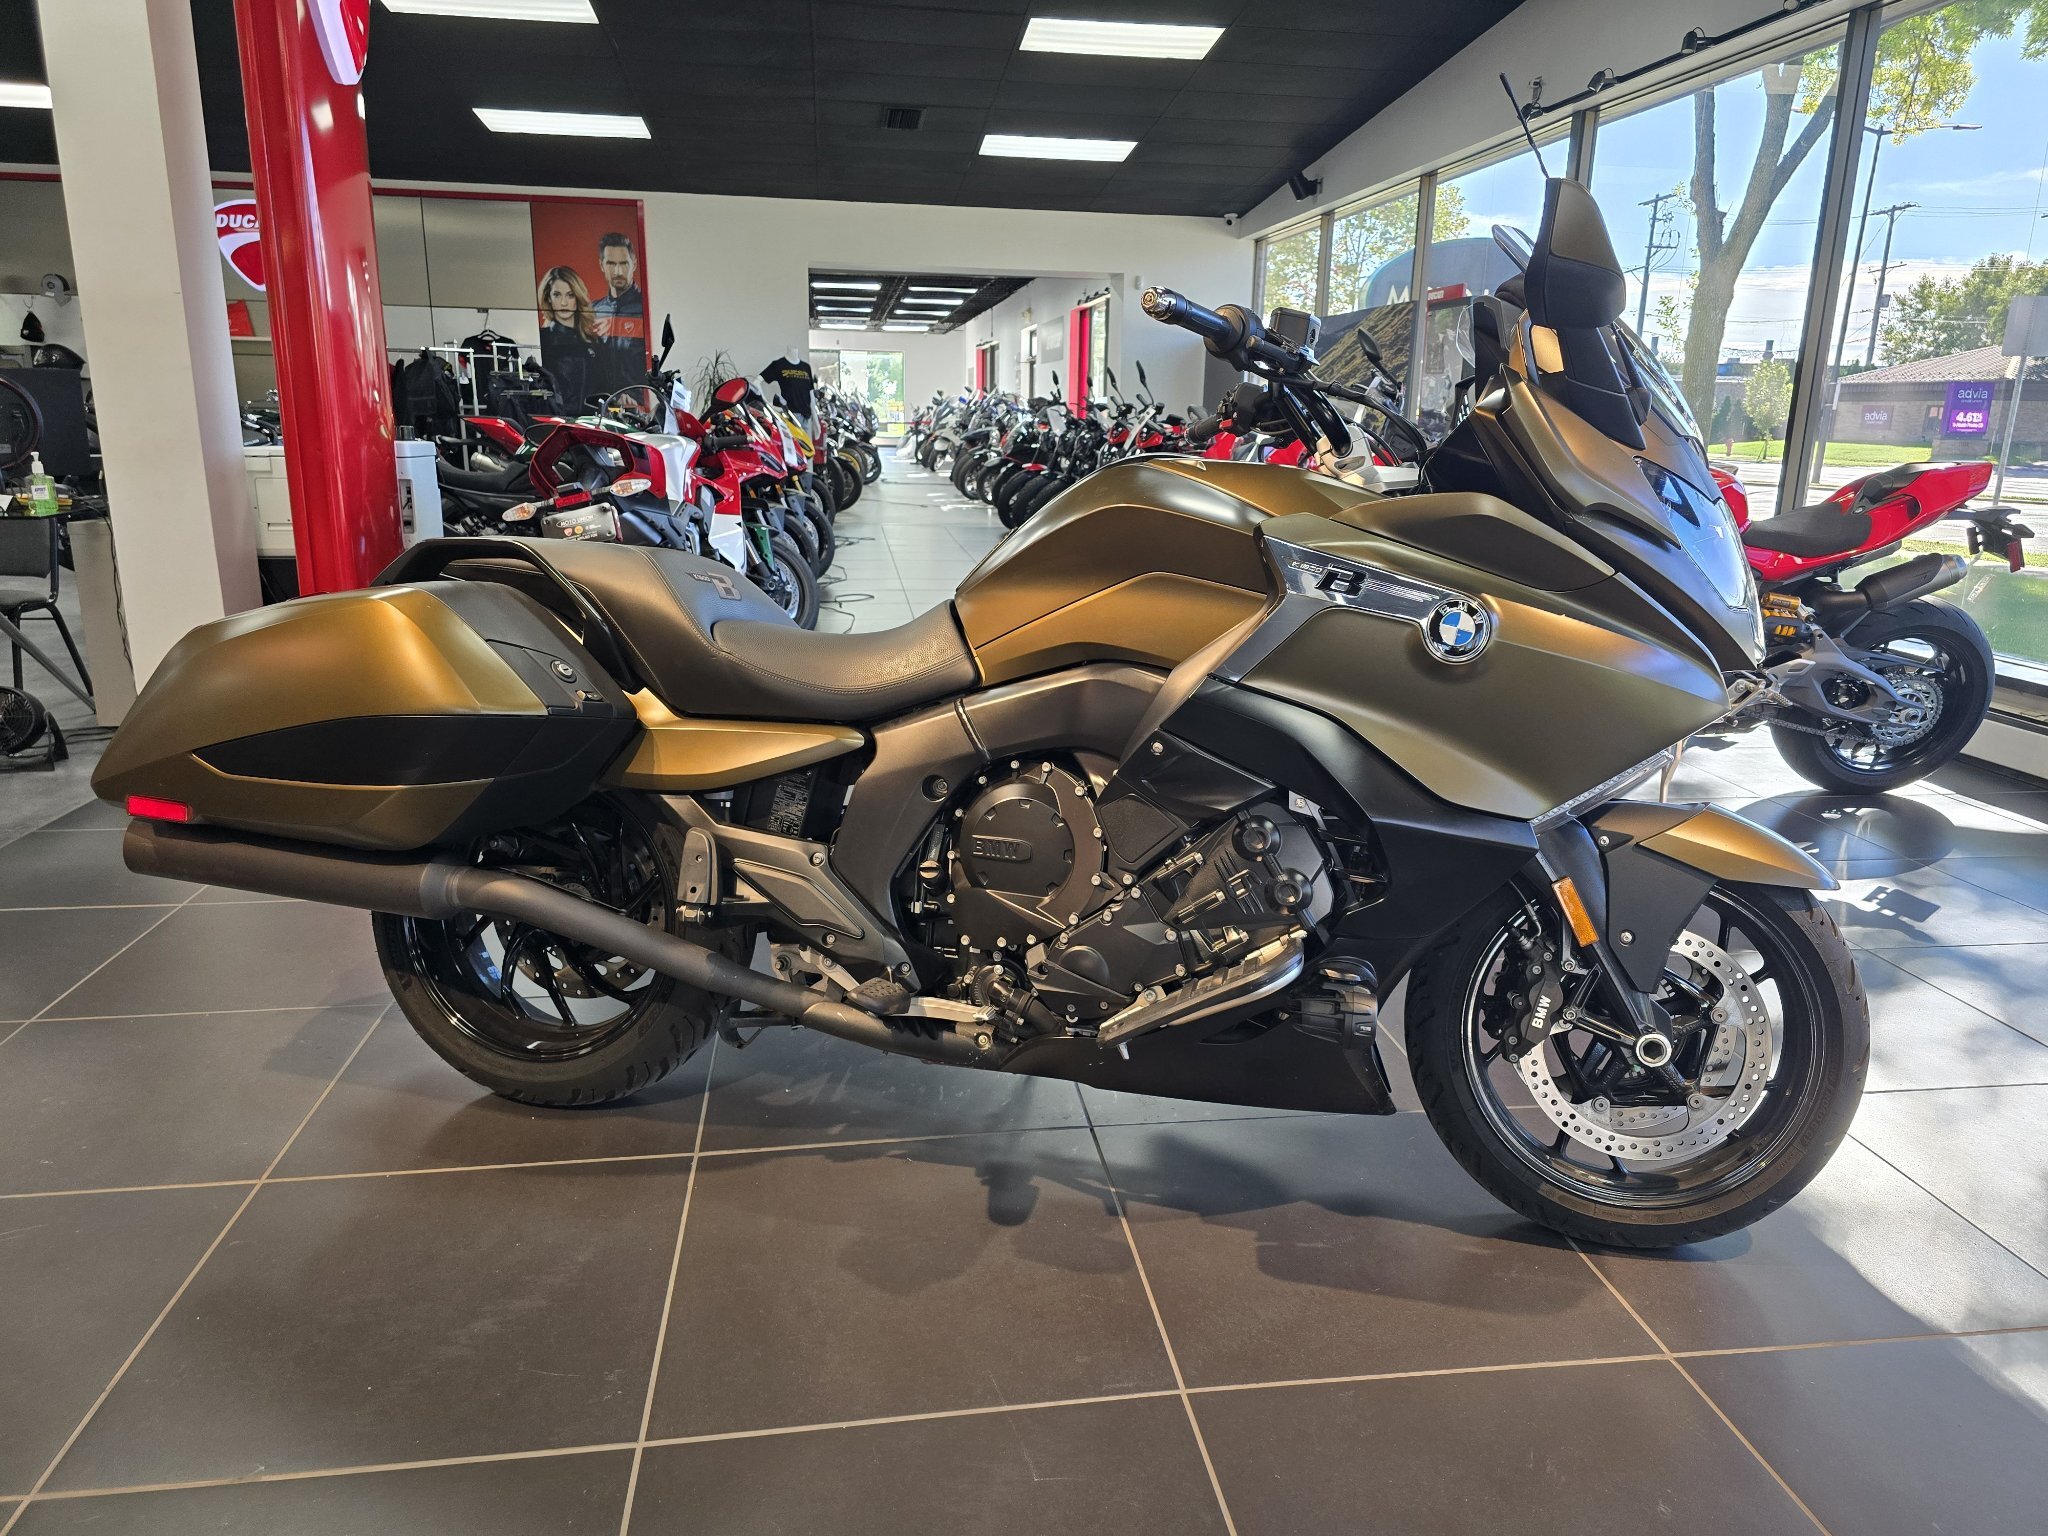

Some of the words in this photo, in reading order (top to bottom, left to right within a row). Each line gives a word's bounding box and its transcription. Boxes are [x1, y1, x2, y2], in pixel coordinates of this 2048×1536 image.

[1957, 388, 1988, 399] advia
[1864, 410, 1888, 421] advia
[973, 840, 1017, 858] BMW
[1531, 994, 1551, 1029] BMW
